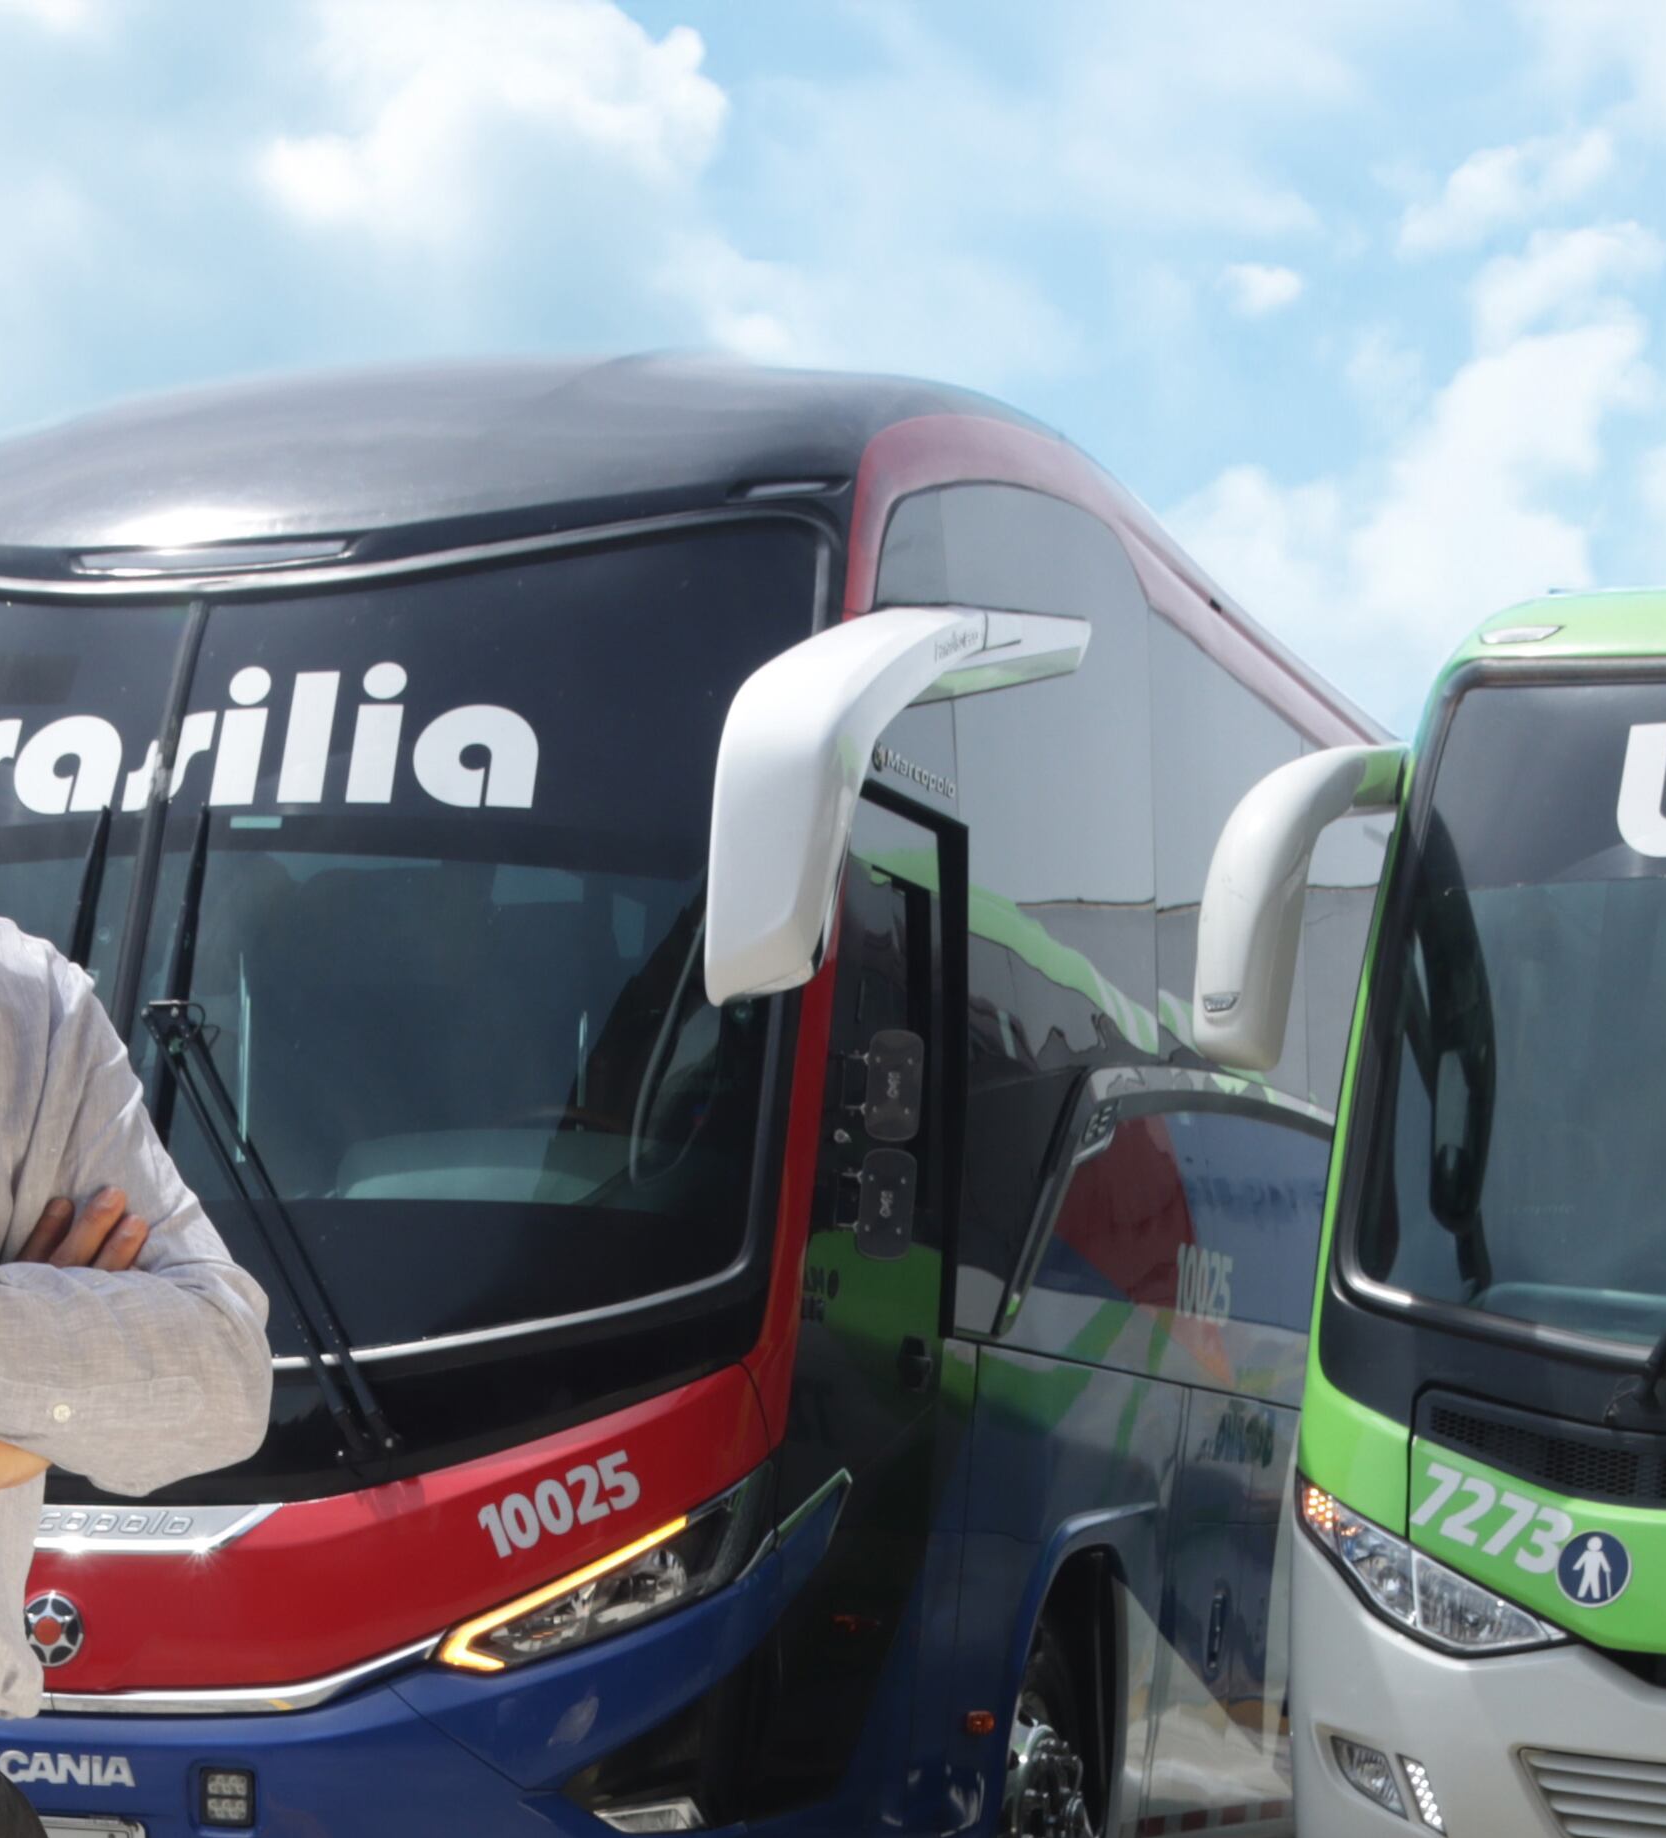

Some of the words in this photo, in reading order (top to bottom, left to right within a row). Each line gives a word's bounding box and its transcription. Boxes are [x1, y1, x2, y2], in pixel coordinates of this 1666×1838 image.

[886, 748, 957, 798] Marcopolo
[1175, 1242, 1233, 1328] 10025
[38, 1509, 194, 1537] copolo
[476, 1449, 642, 1559] 10025
[1409, 1462, 1573, 1576] 7273
